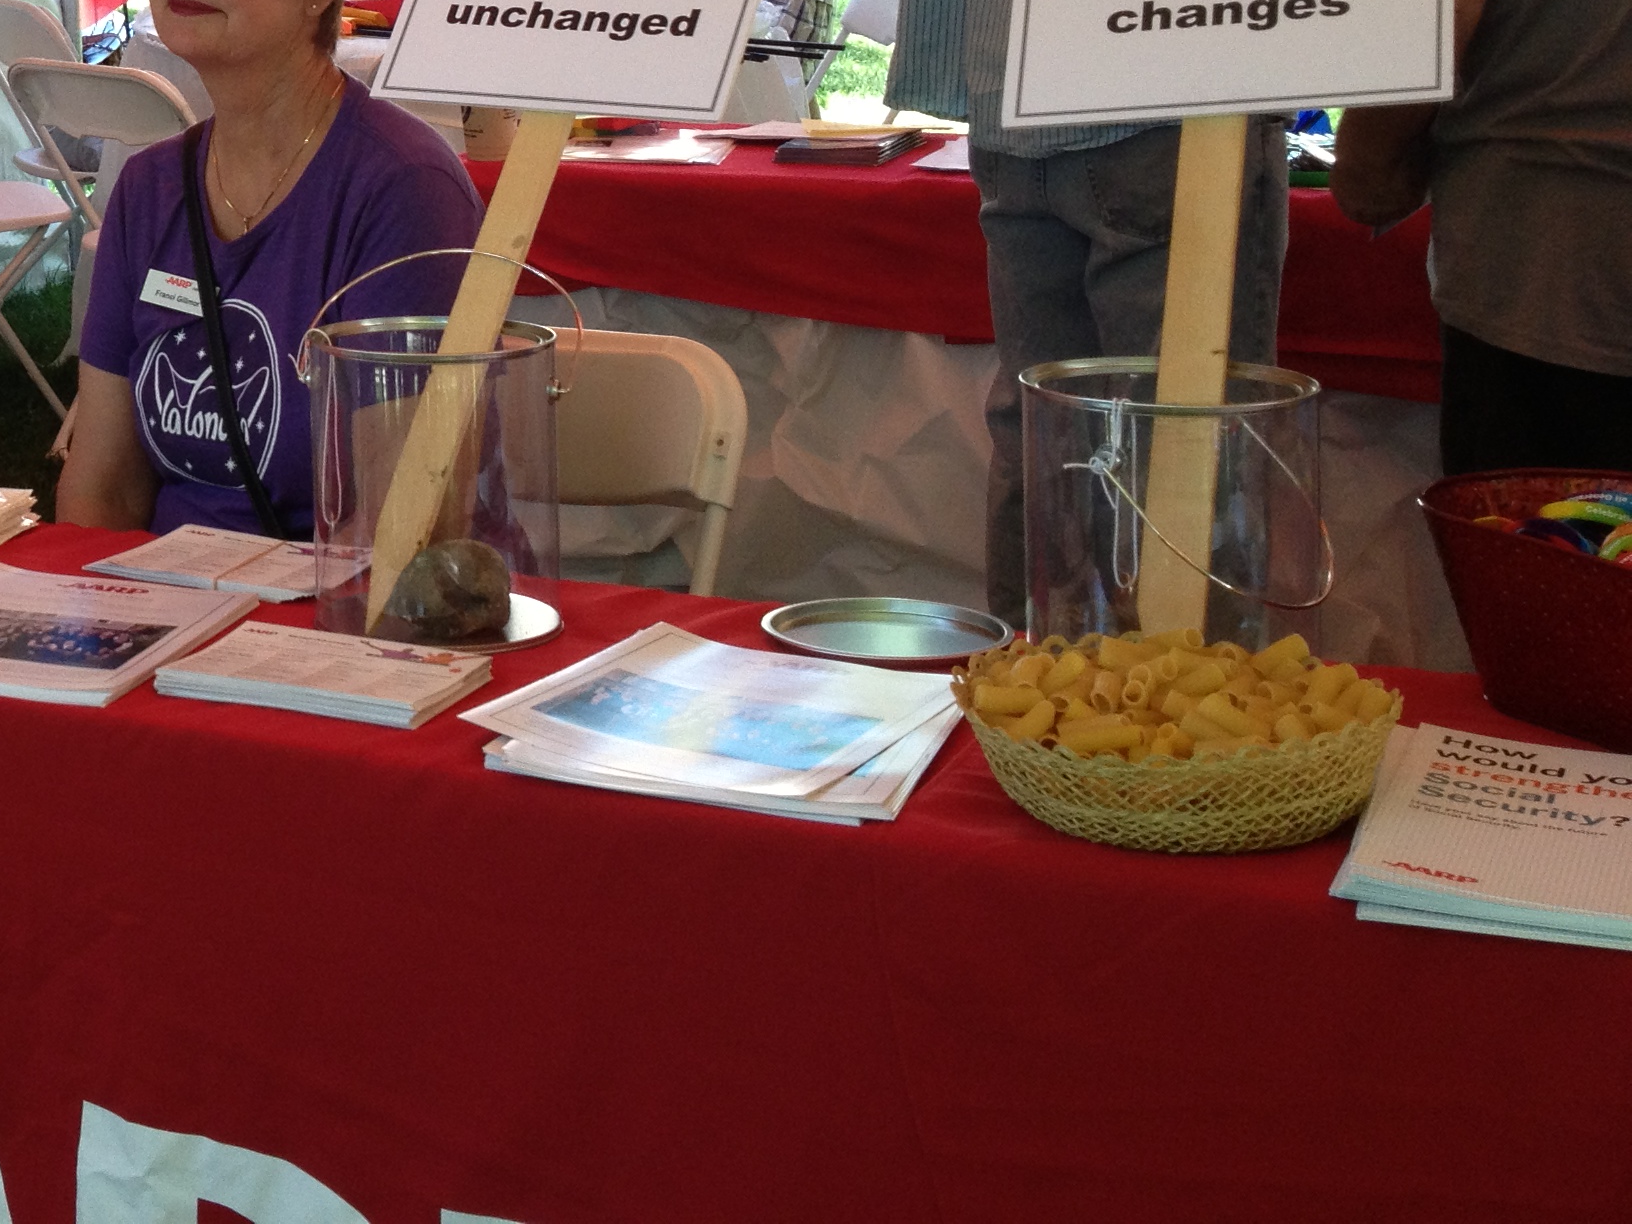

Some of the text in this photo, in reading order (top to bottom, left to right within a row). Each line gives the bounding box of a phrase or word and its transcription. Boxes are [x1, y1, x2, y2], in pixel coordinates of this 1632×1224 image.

[446, 2, 701, 41] unchanged
[165, 276, 192, 288] AARP
[56, 582, 150, 594] AARP
[1442, 735, 1539, 760] How
[1436, 748, 1566, 778] would
[1423, 772, 1556, 804] Social
[1418, 784, 1631, 828] Security?
[1382, 860, 1479, 883] AARP
